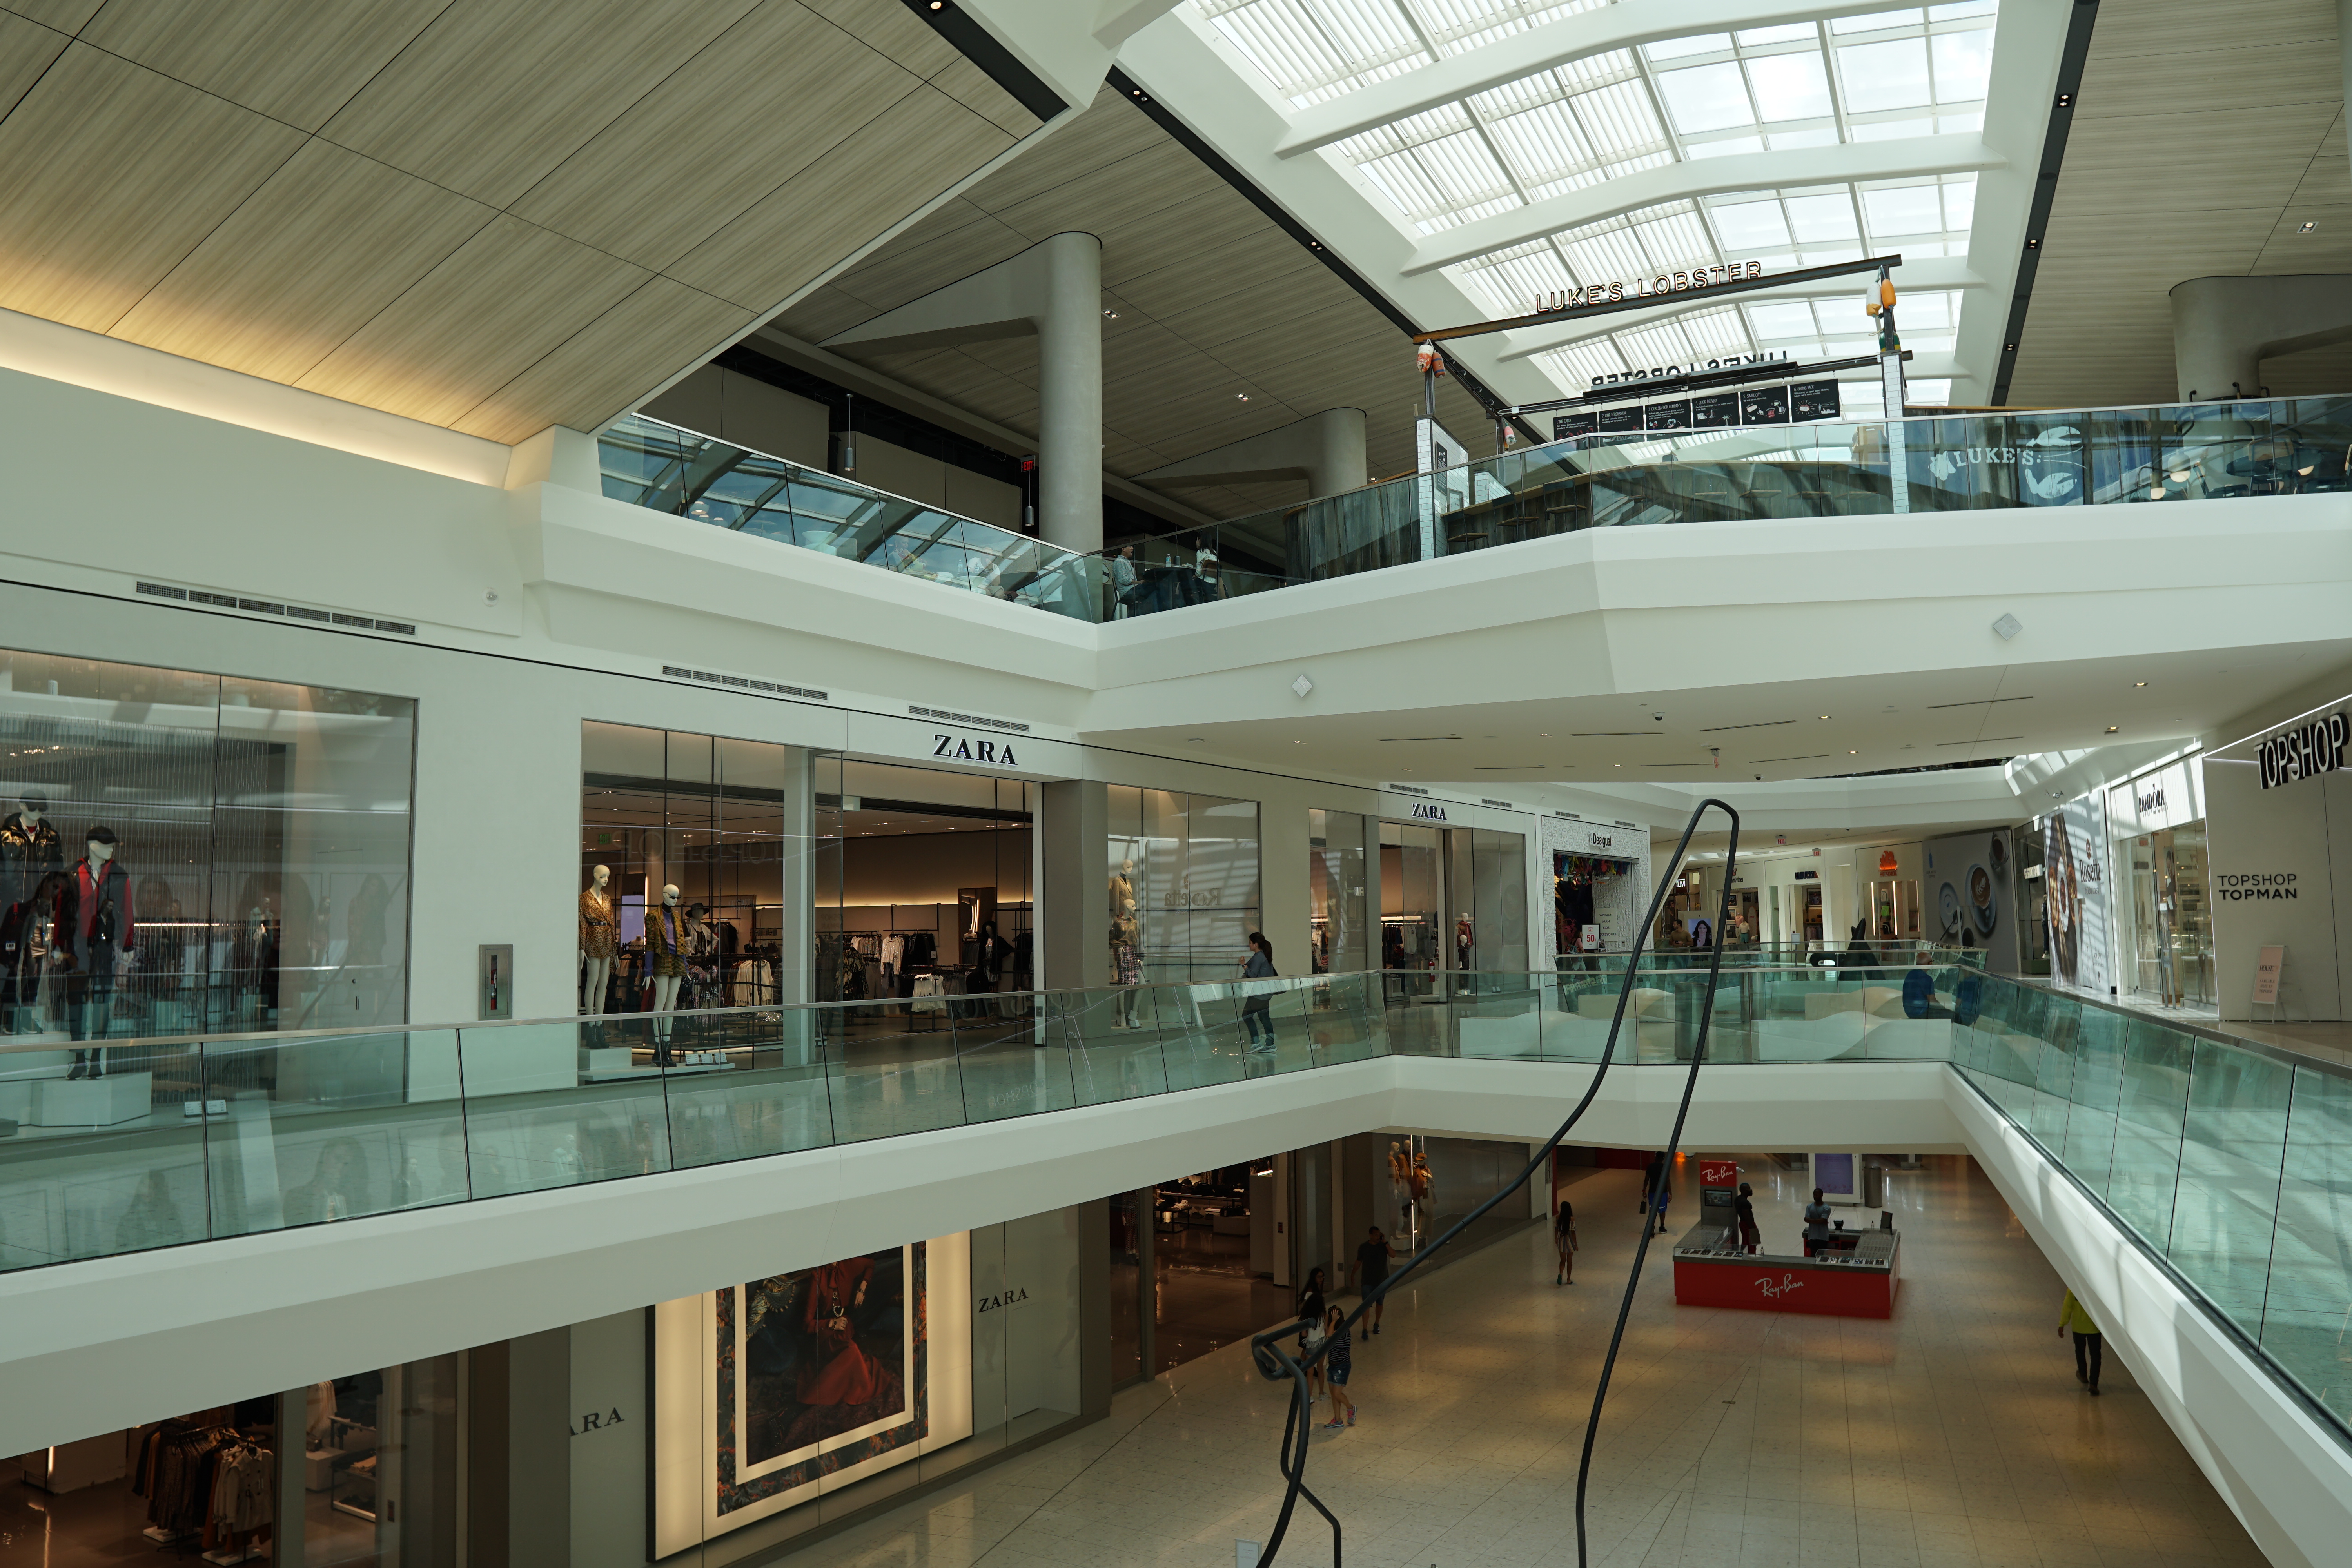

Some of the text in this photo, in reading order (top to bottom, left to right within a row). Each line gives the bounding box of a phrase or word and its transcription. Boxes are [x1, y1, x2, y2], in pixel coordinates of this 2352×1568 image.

[1536, 261, 1761, 314] LUKE'S LOBSTER
[1024, 461, 1033, 471] EXIT
[1953, 448, 2034, 467] LUKE'S
[933, 734, 1018, 766] ZARA
[2254, 713, 2350, 789] TOPSHOP
[2139, 785, 2165, 813] PANDORA
[1412, 803, 1447, 821] ZARA
[1593, 833, 1611, 848] Desigual
[2079, 858, 2101, 882] Rosetta
[2217, 874, 2296, 886] TOPSHOP
[2219, 888, 2297, 900] TOPMAN
[1702, 1166, 1733, 1182] Ray-Ban
[1755, 1273, 1804, 1298] Ray-Ban
[978, 1287, 1028, 1313] ZARA
[570, 1407, 624, 1436] RA
